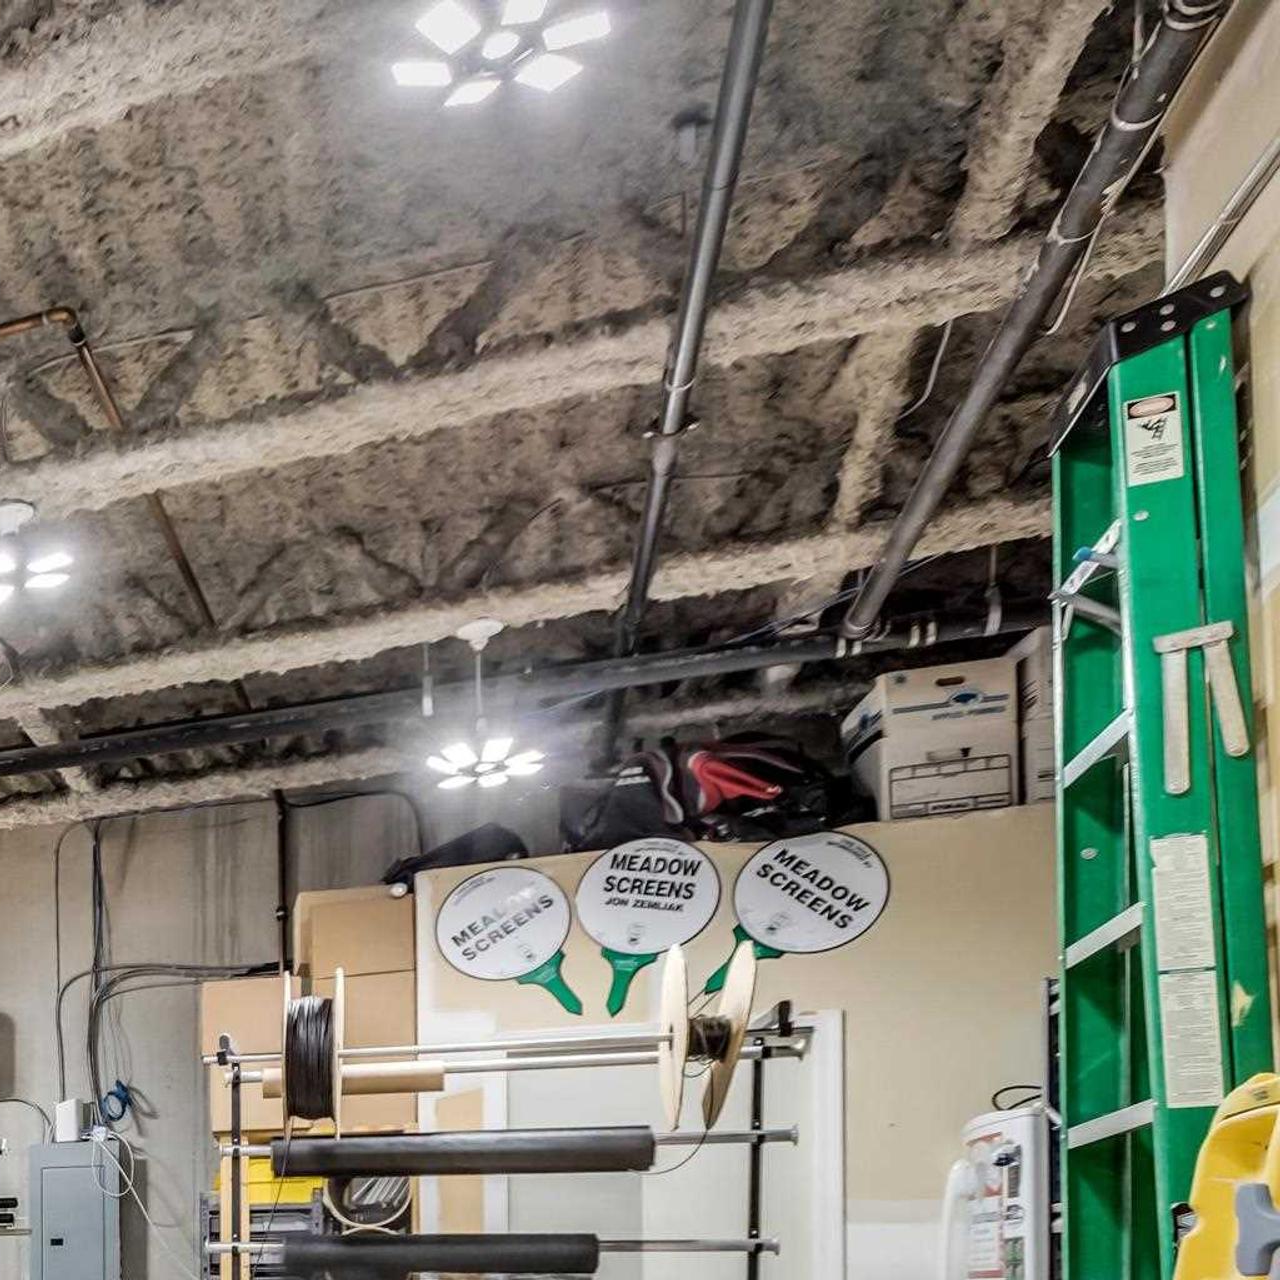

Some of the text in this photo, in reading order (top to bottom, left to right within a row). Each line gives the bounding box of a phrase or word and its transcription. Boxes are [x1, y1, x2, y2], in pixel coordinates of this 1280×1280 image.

[603, 875, 695, 900] SCREENS
[610, 853, 702, 877] MEADOW
[756, 863, 854, 929] SCREENS
[774, 848, 871, 912] MEADOW
[461, 895, 554, 961] SCREENS
